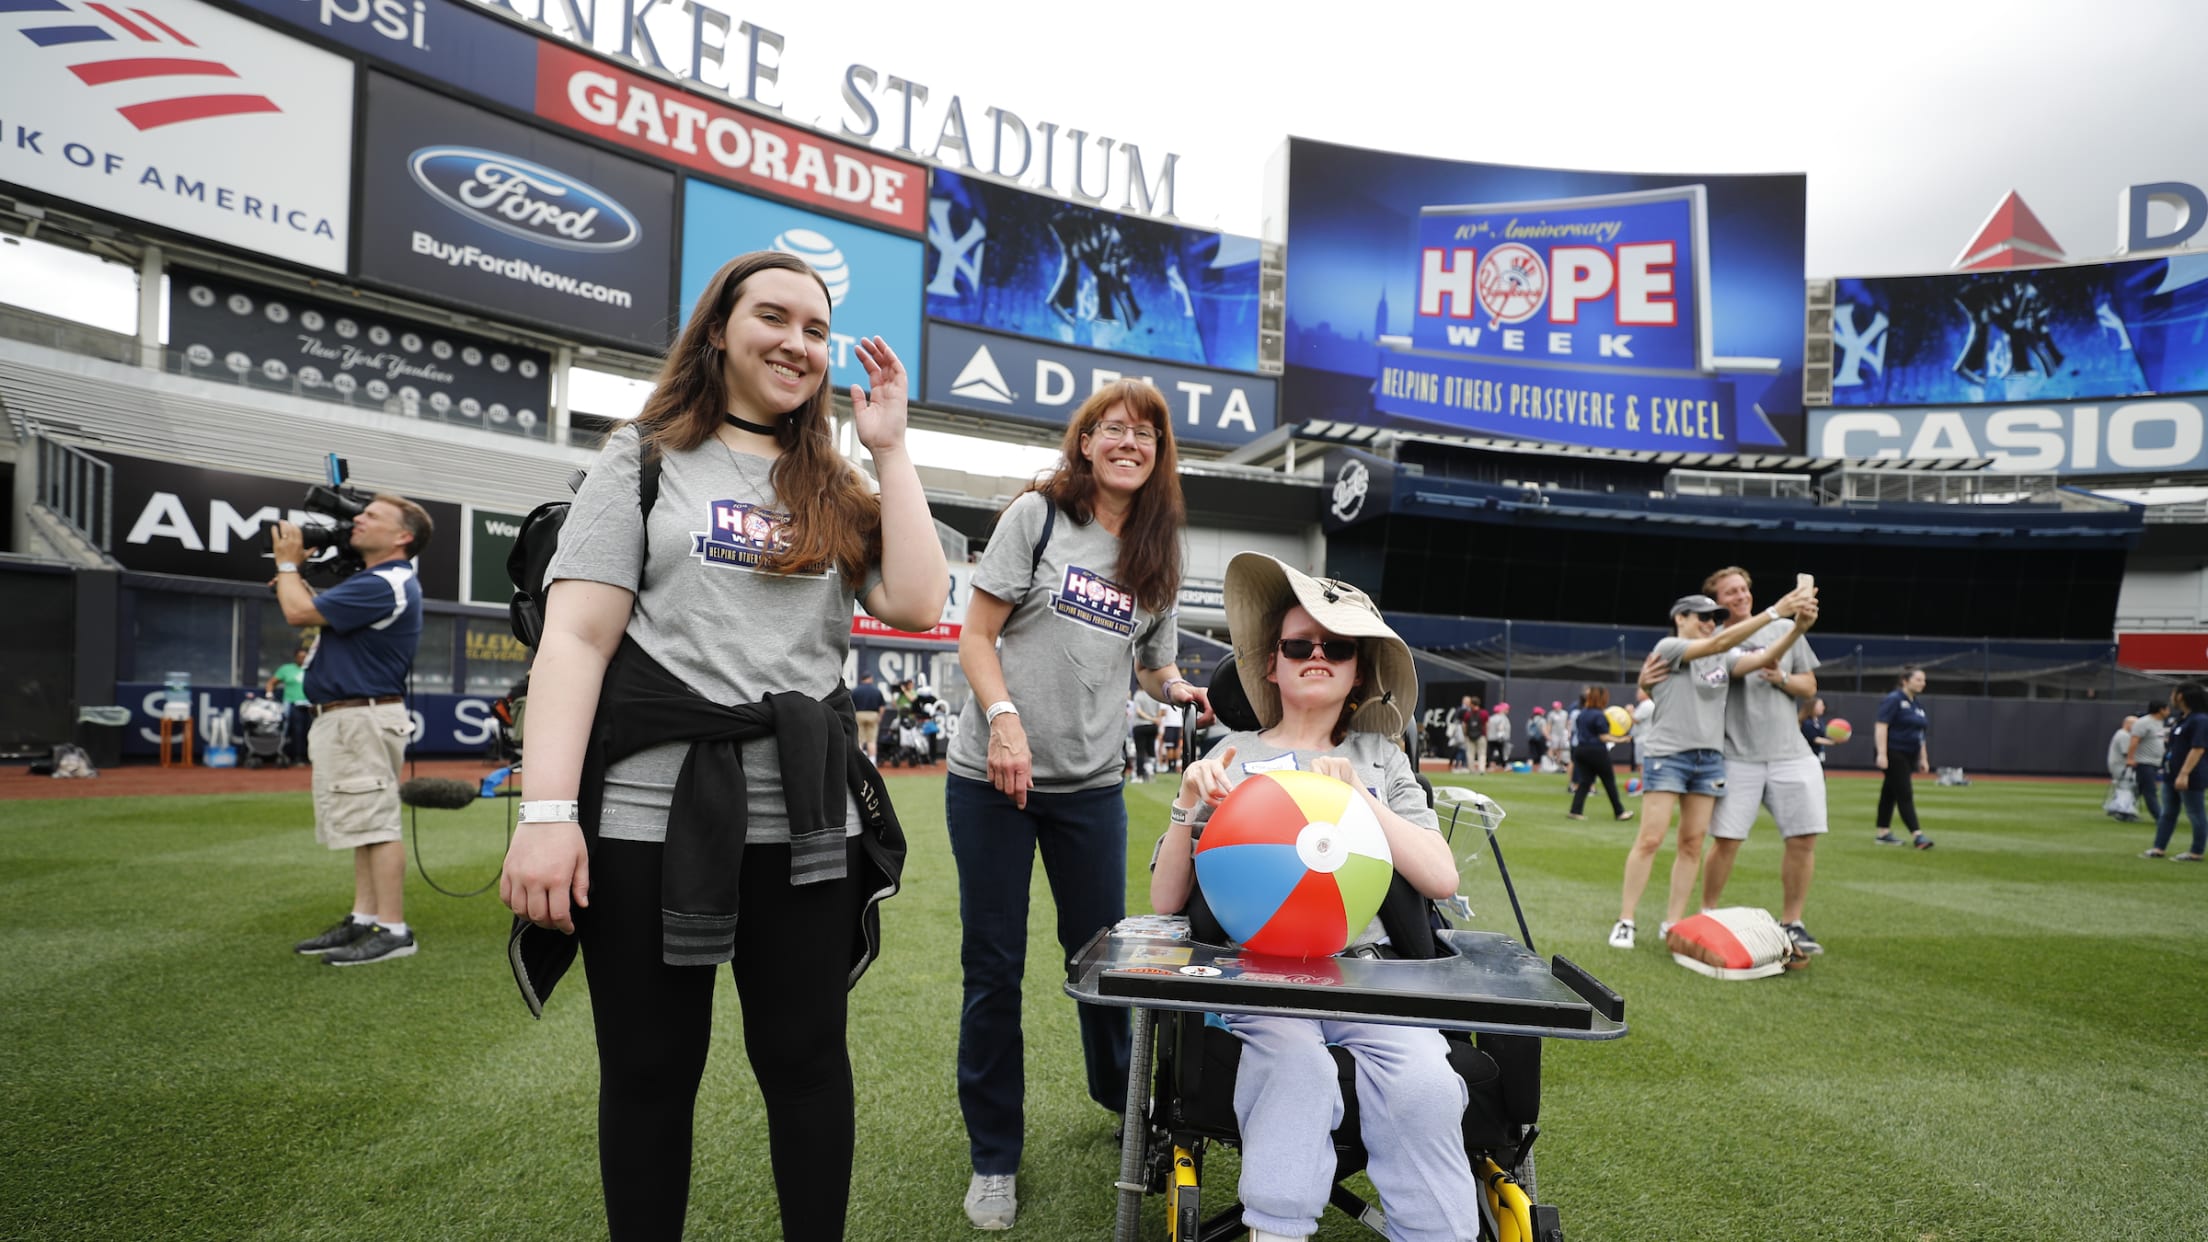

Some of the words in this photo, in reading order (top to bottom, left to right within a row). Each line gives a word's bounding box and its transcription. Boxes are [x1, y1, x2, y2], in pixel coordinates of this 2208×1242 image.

[497, 0, 786, 108] NKEE
[841, 63, 1182, 219] STADIUM
[567, 69, 905, 215] GATORADE
[0, 119, 44, 156] K
[63, 142, 125, 175] OF
[138, 164, 335, 241] AMERICA
[459, 159, 596, 242] Ford
[1490, 217, 1624, 243] Anniversary
[411, 230, 633, 309] BuyFordNow.com
[1418, 240, 1678, 330] HOPE
[297, 334, 341, 360] New
[341, 345, 386, 371] York
[385, 353, 455, 384] Yankees
[1447, 325, 1634, 358] WEEK
[1035, 358, 1256, 433] DETA
[1381, 366, 1439, 404] HELPING
[1443, 375, 1503, 414] OTHERS
[1509, 383, 1616, 430] PERSEVERE
[1625, 394, 1641, 431] &
[1650, 396, 1725, 441] EXCEL
[1822, 401, 2205, 472] CASIO
[709, 545, 737, 562] HELPING
[1068, 572, 1132, 613] HOPE
[1075, 594, 1123, 617] WEEK
